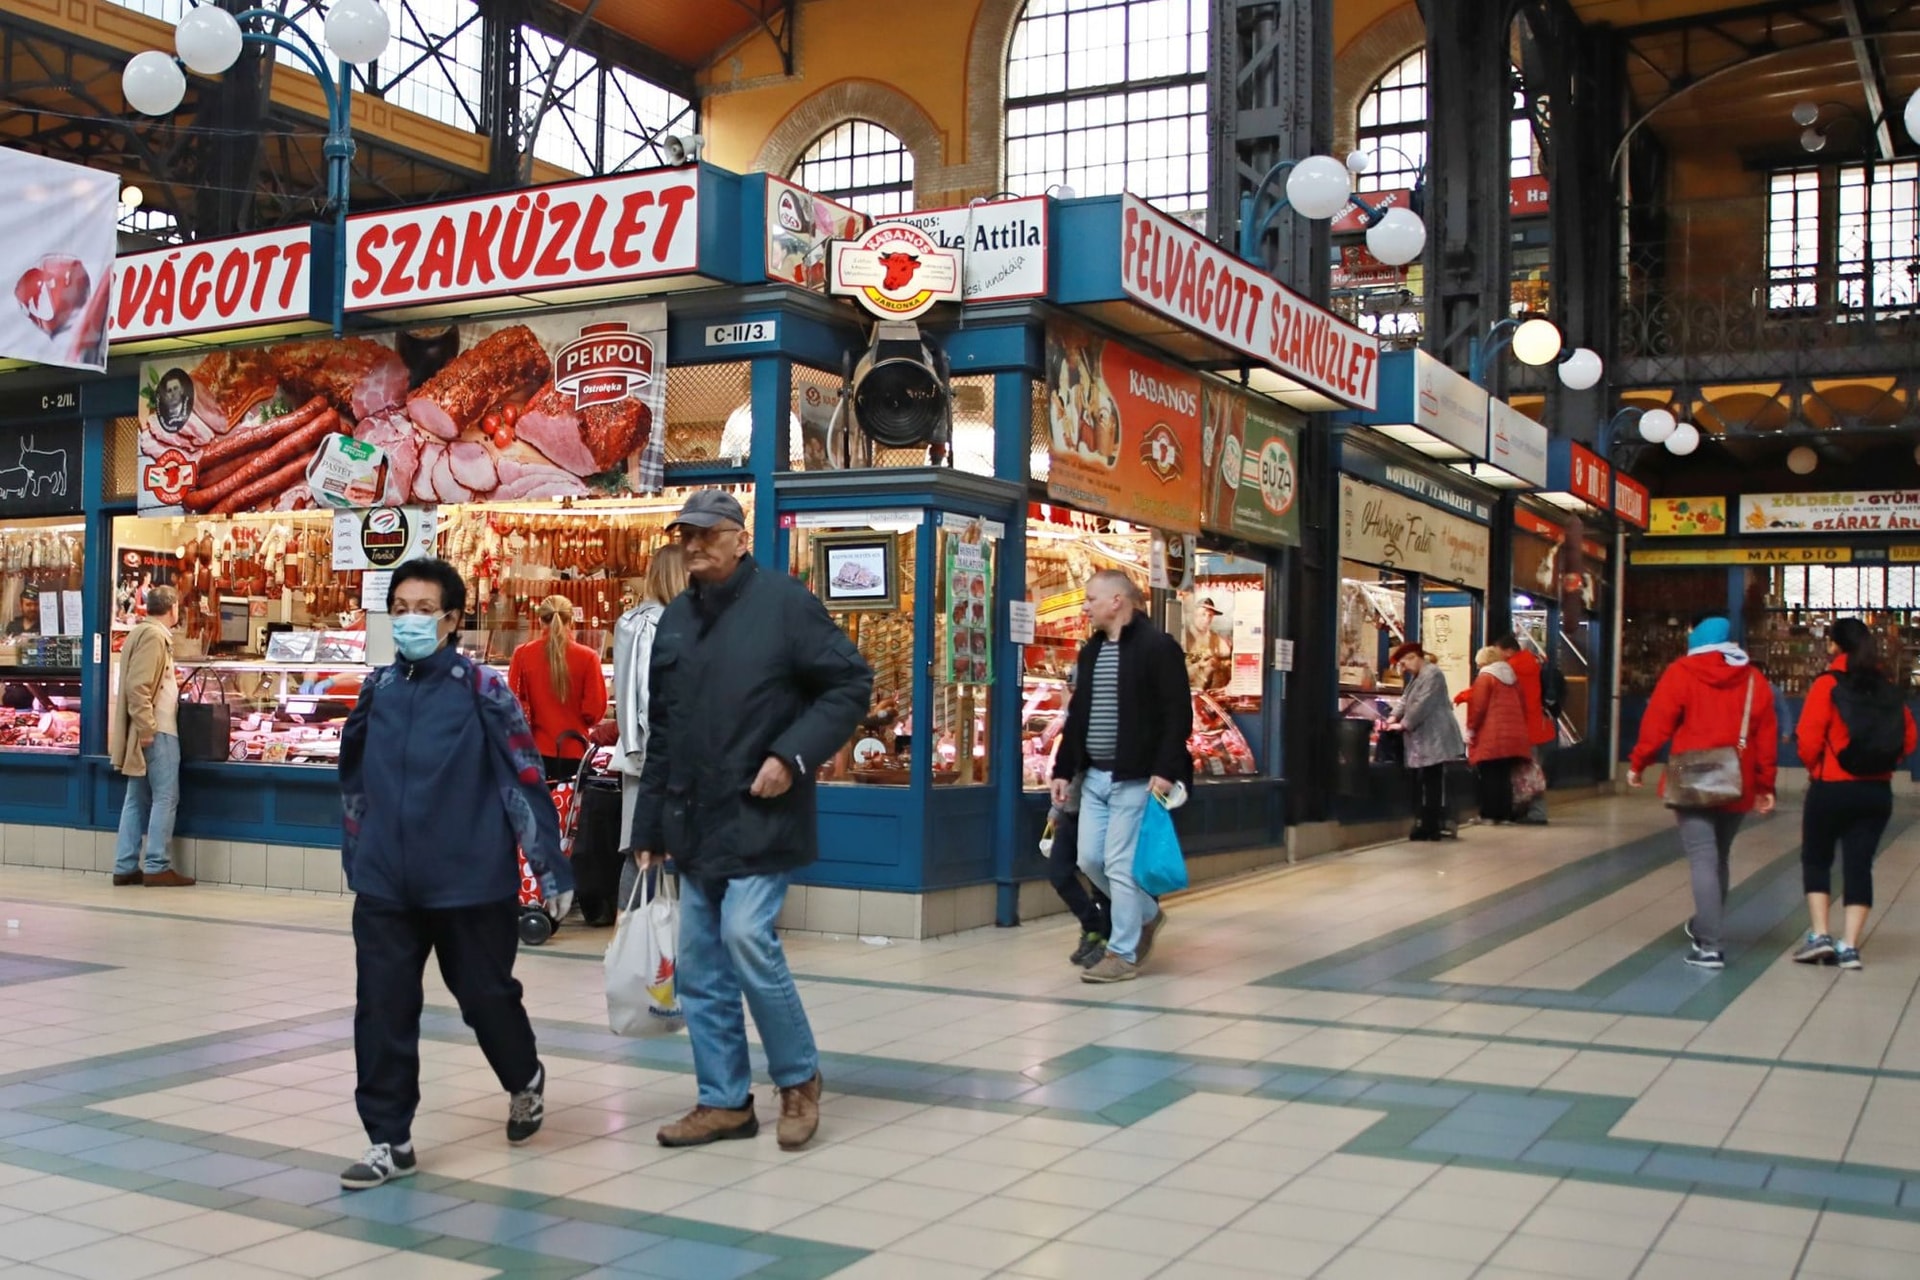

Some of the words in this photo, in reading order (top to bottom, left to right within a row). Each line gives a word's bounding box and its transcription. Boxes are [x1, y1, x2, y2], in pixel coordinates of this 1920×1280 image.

[352, 191, 695, 299] SZAKÜZLET
[866, 230, 931, 254] KABANOS
[974, 219, 1041, 252] Attila
[109, 241, 312, 330] VÁGOTT
[1123, 206, 1264, 345] FELVÁGOTT
[1270, 291, 1376, 400] SZAKÜZLET
[566, 343, 645, 373] PEKPOL
[1128, 368, 1198, 418] KABANOS
[1812, 512, 1882, 531] SZÁRAZ
